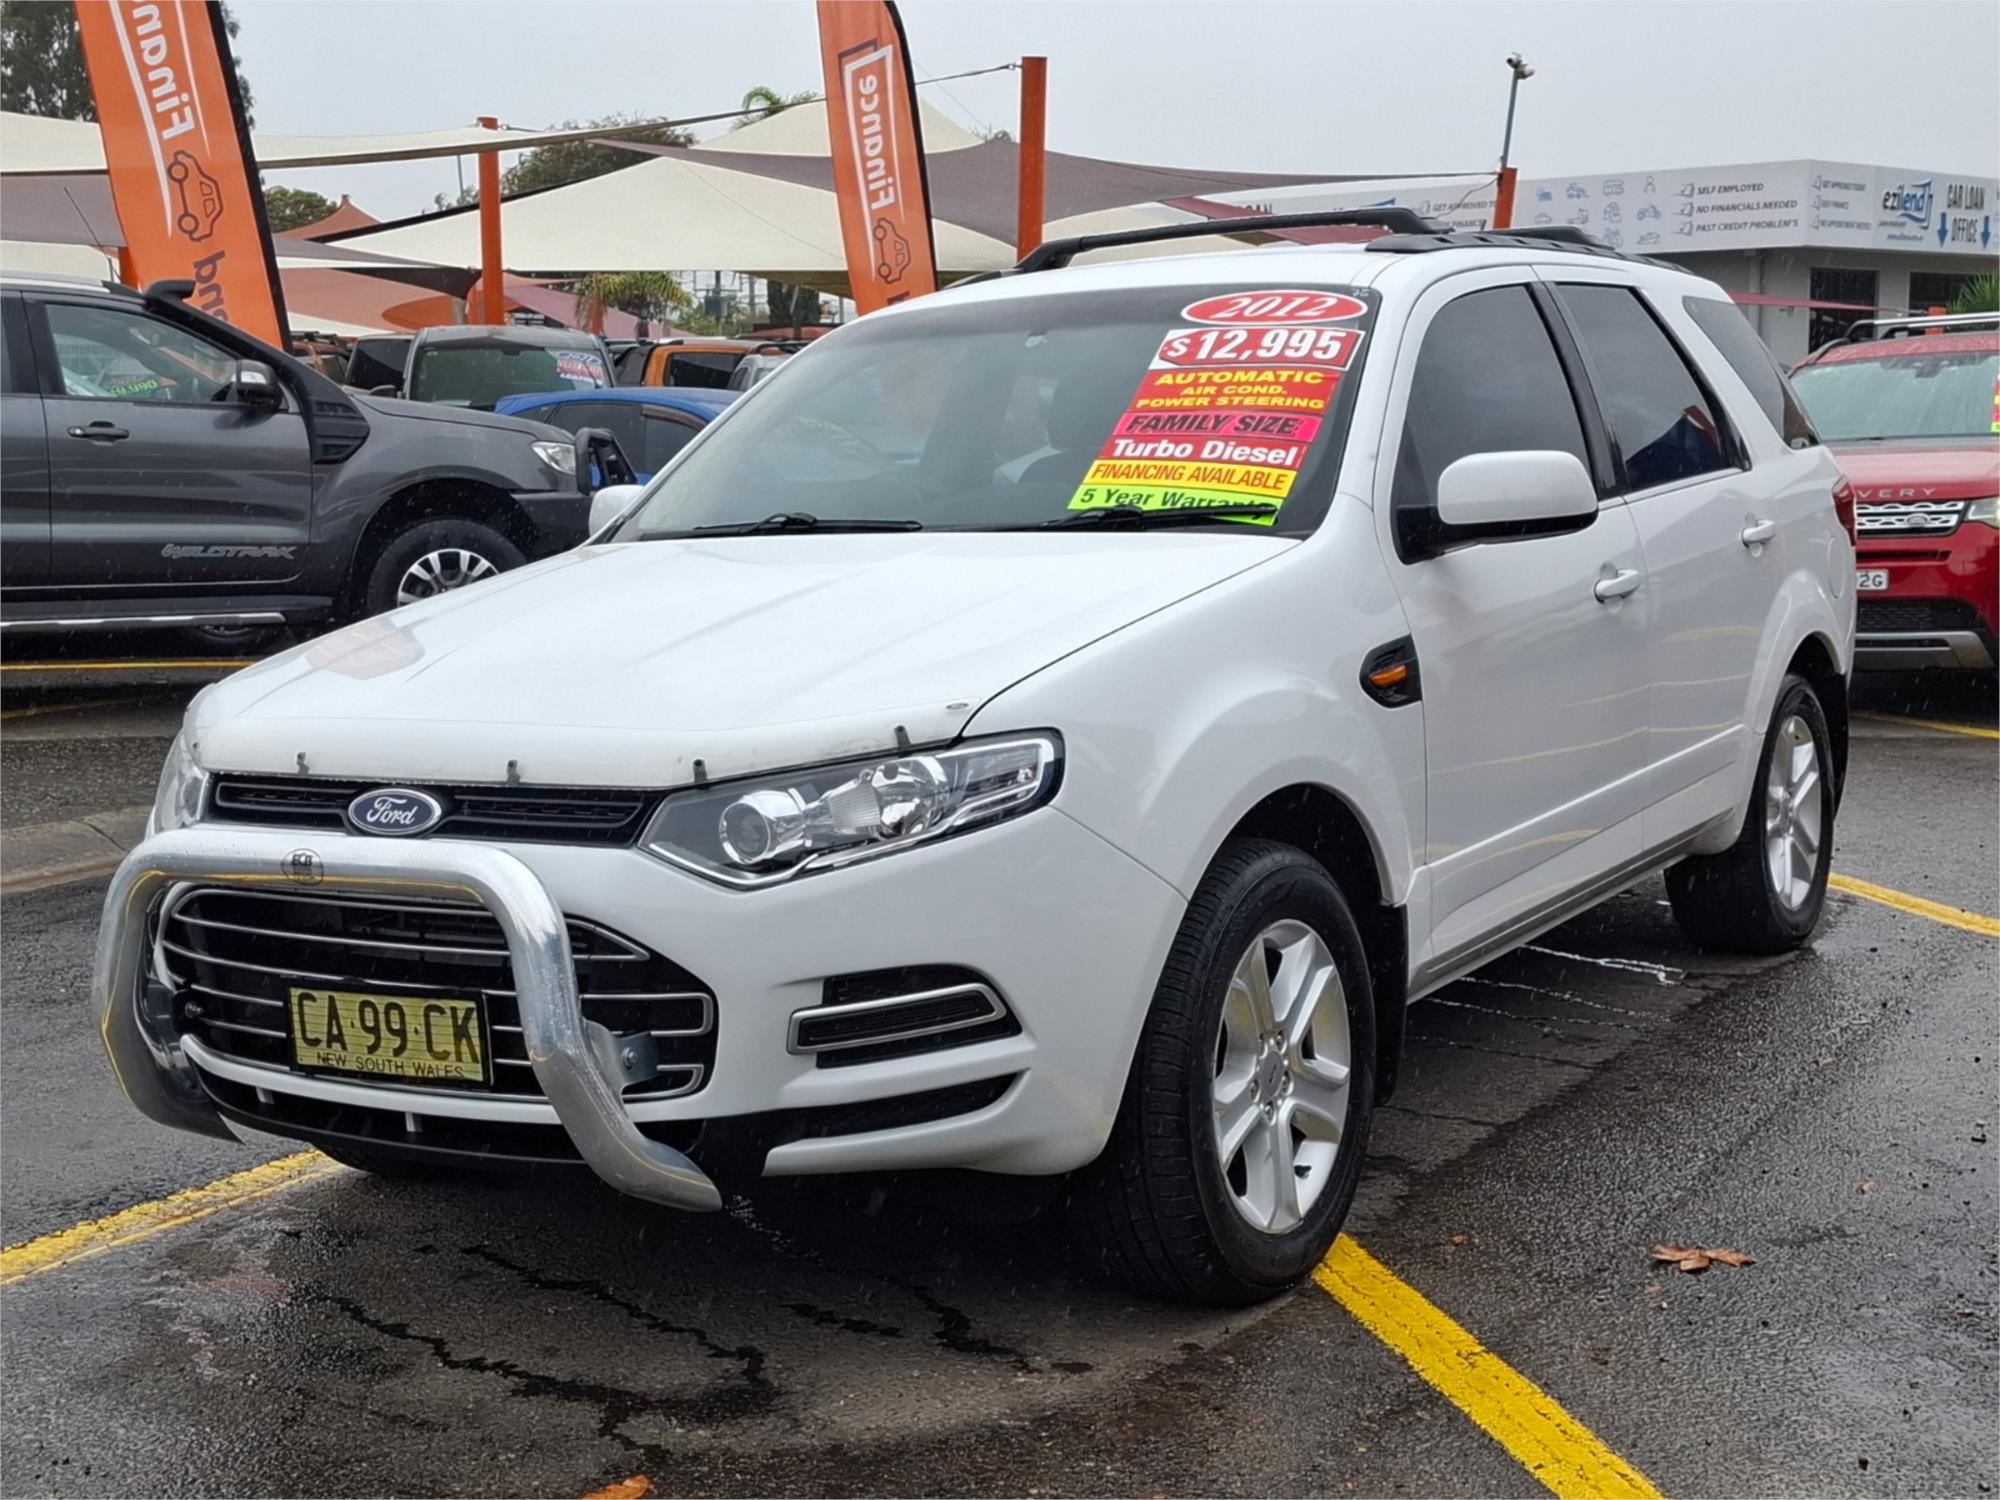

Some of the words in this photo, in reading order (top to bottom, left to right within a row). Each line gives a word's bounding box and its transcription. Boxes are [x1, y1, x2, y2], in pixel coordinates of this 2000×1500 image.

[1696, 185, 1715, 195] SELF
[1718, 183, 1764, 194] EMPLOYED
[1947, 184, 1963, 209] CAR
[1965, 185, 1985, 210] LOAN
[1696, 205, 1709, 213] NO
[1711, 202, 1760, 212] FINANCIALS
[1762, 200, 1798, 209] NEEDED
[1696, 223, 1716, 232] PAST
[1718, 221, 1747, 231] CREDIT
[1750, 218, 1799, 229] PROBLEM'S
[1951, 216, 1978, 244] OFFICE
[1208, 296, 1339, 320] 2012
[1166, 328, 1348, 362] $12,995
[1153, 371, 1325, 385] AUTOMATIC
[1180, 385, 1218, 396] AIR
[1223, 385, 1288, 395] COND.
[1135, 398, 1212, 409] POWER
[1216, 397, 1325, 410] STEERING
[1124, 414, 1234, 434] FAMILY
[1233, 415, 1300, 434] SIZE
[1112, 439, 1193, 459] Turbo
[1201, 440, 1298, 467] Diesel
[1091, 463, 1184, 482] FINANCING
[1186, 467, 1289, 491] AVAILABLE
[1079, 488, 1097, 505] 5
[1103, 489, 1155, 507] Year
[366, 796, 418, 825] Ford
[316, 1051, 347, 1068] NEW
[355, 1056, 405, 1073] SOUTH
[412, 1061, 465, 1079] WALES
